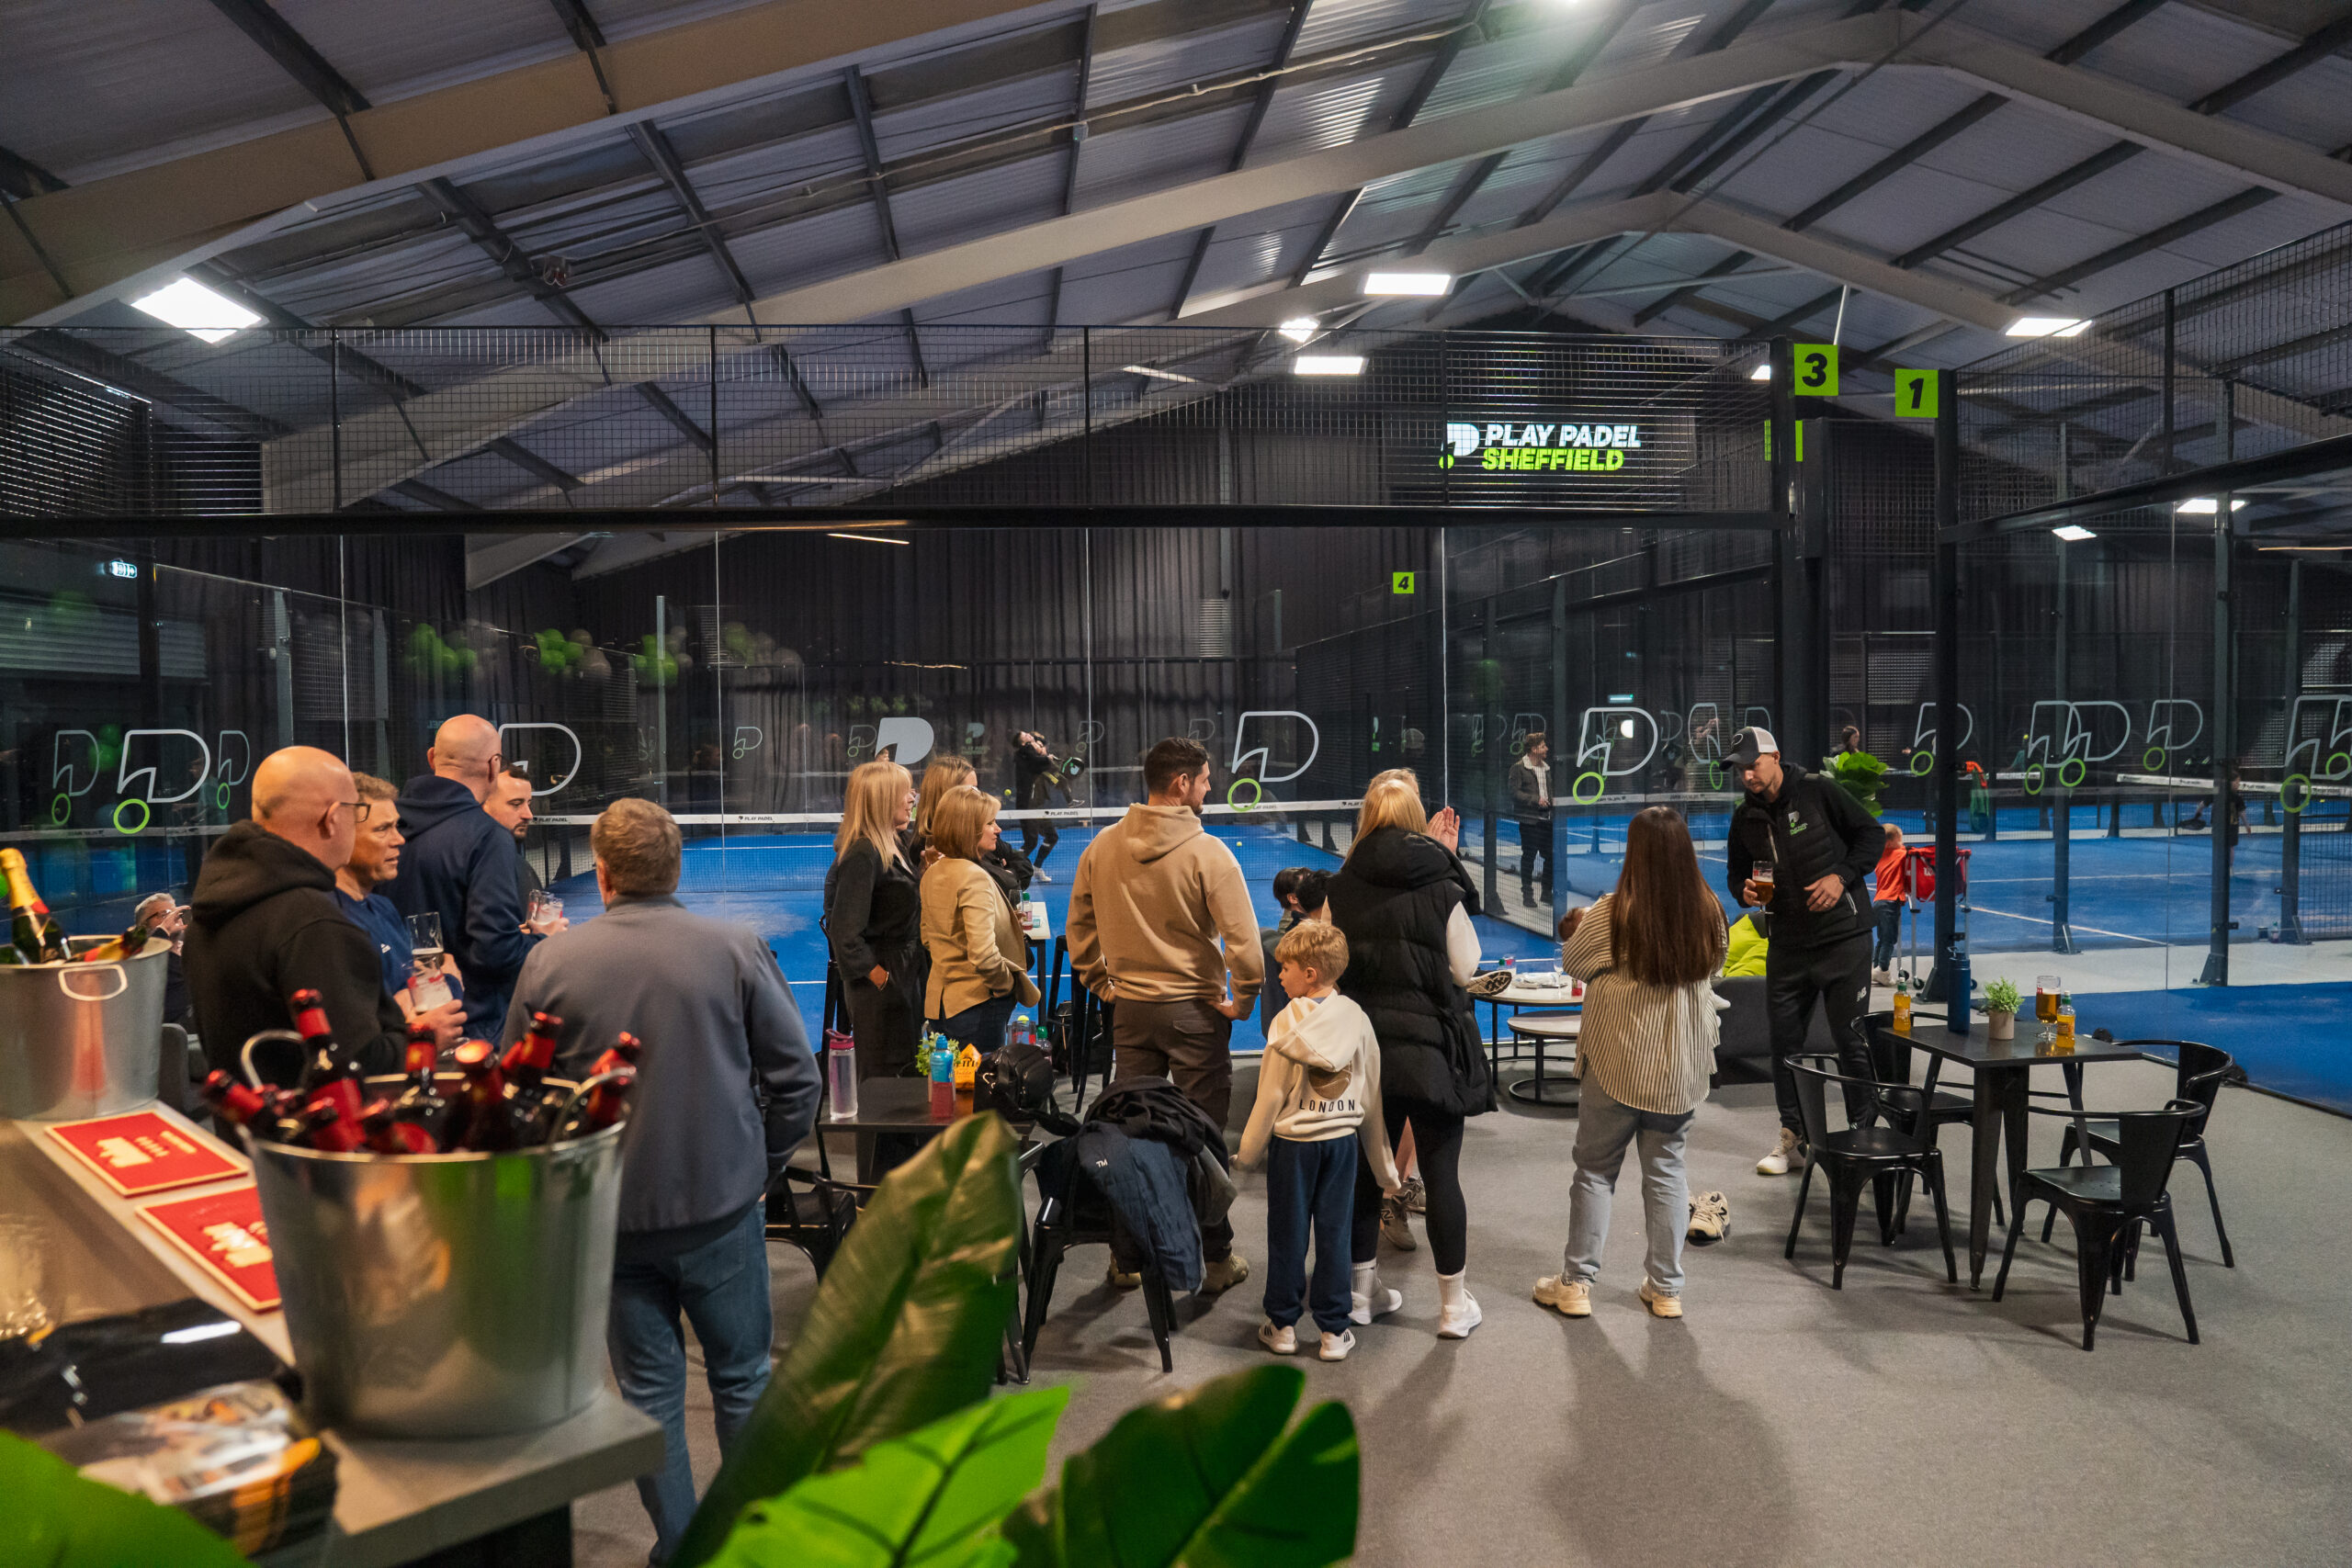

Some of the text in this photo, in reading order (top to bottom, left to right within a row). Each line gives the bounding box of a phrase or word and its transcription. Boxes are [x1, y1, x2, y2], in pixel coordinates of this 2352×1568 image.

[1801, 352, 1828, 388] 3
[1908, 378, 1925, 410] 1
[1484, 423, 1642, 448] PLAY PADEL
[1481, 447, 1625, 471] SHEFFIELD
[1397, 575, 1409, 590] 4
[1298, 1099, 1355, 1113] LONDON
